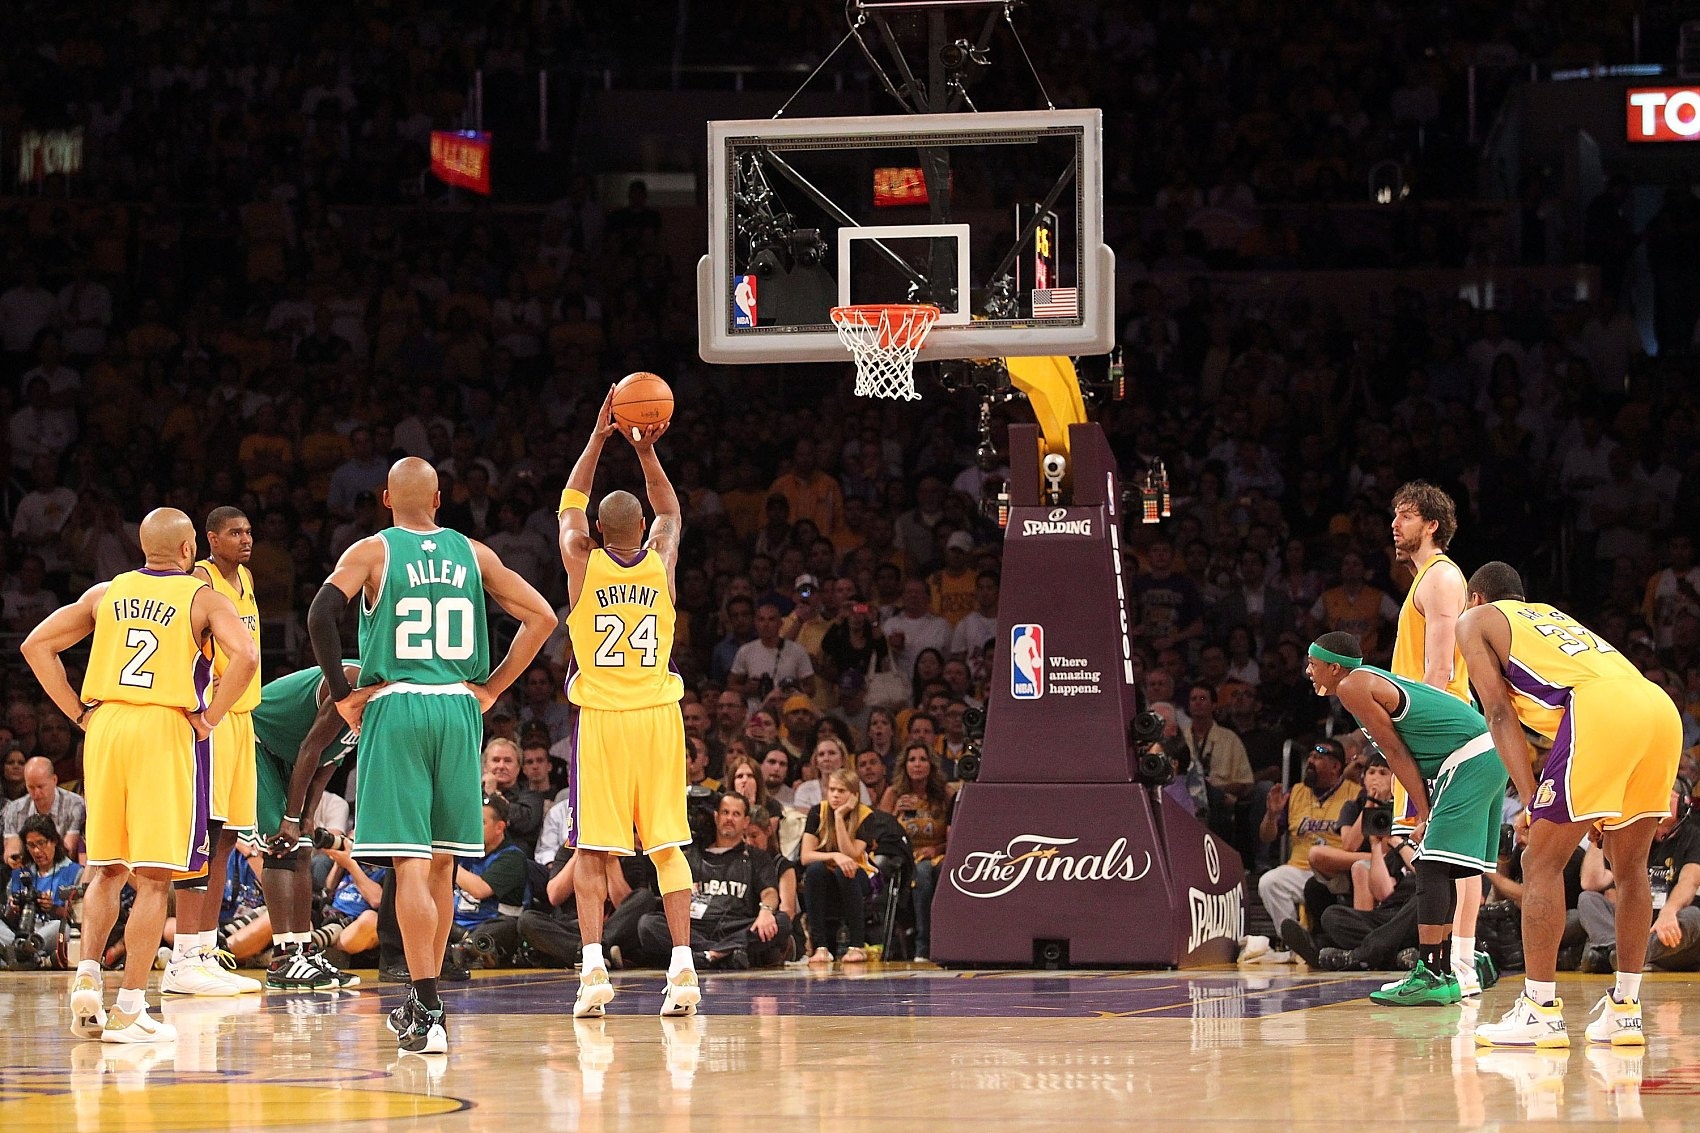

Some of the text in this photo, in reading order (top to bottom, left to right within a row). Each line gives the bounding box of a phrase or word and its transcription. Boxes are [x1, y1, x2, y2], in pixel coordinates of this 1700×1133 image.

[1630, 91, 1700, 136] TO
[1022, 519, 1092, 536] SPALDING
[405, 559, 467, 588] ALLEN
[595, 584, 659, 608] BRYANT
[113, 598, 177, 627] FISHER
[395, 597, 474, 660] 20
[594, 614, 658, 667] 24
[118, 627, 159, 689] 2
[1049, 657, 1088, 667] Where
[1015, 683, 1033, 694] NBA
[1049, 670, 1101, 682] amazing
[1049, 684, 1102, 696] happens.
[950, 834, 1152, 898] The Finals
[1187, 881, 1244, 954] SPALDING
